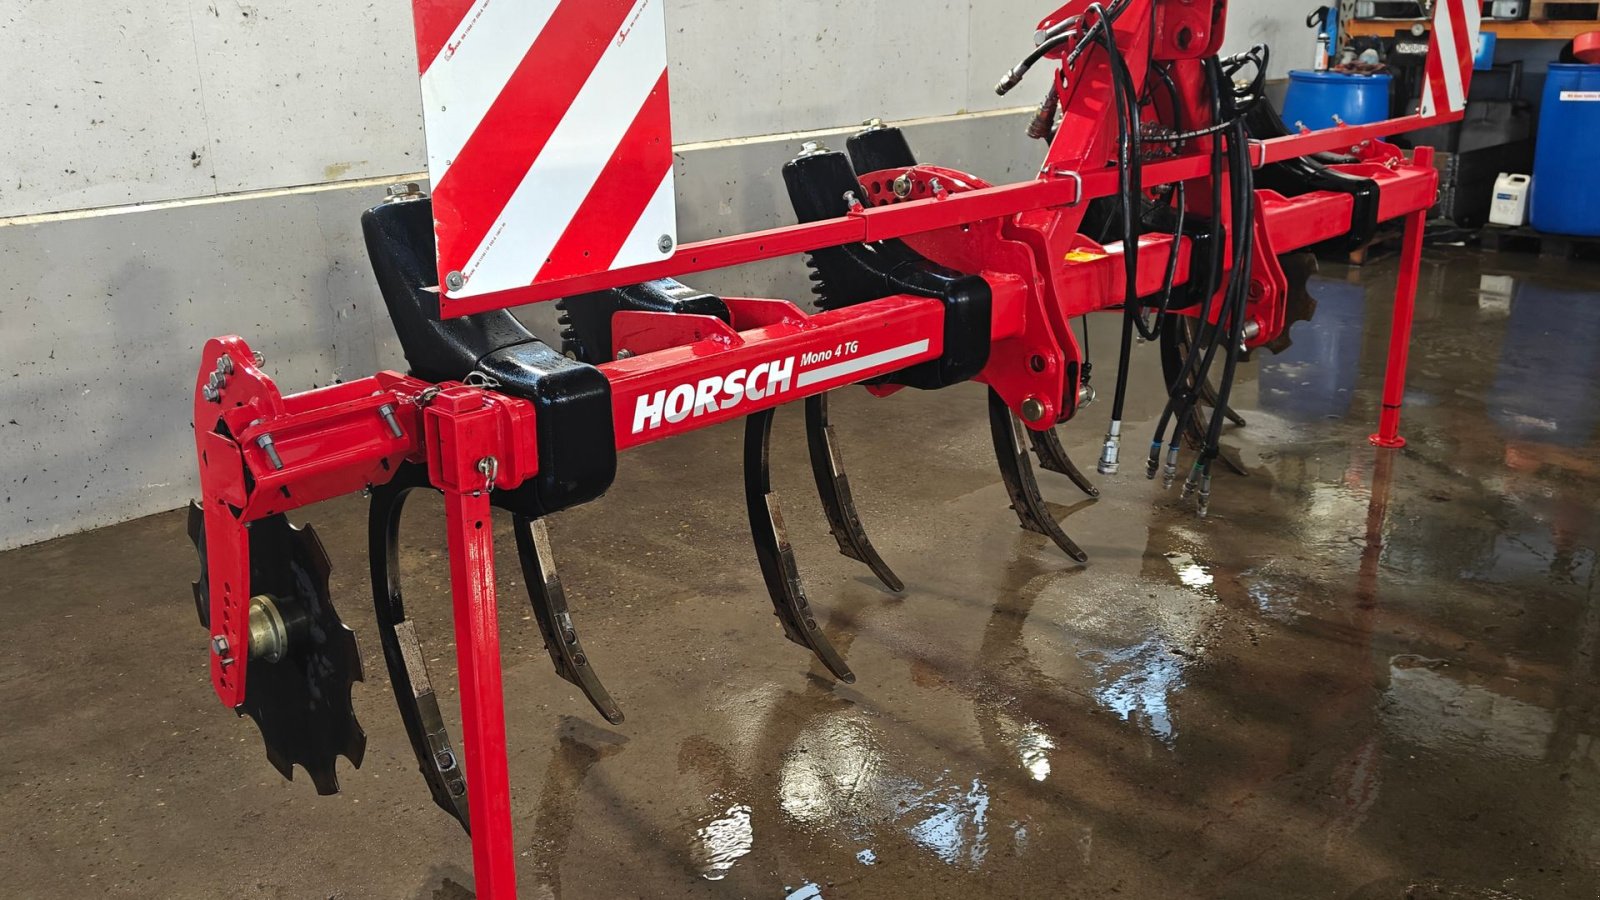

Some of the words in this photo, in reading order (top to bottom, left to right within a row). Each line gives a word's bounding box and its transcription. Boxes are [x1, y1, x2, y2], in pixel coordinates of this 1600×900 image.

[631, 355, 795, 434] HORSCH
[800, 351, 832, 367] Mono
[834, 343, 842, 357] 4
[845, 340, 859, 355] TG
